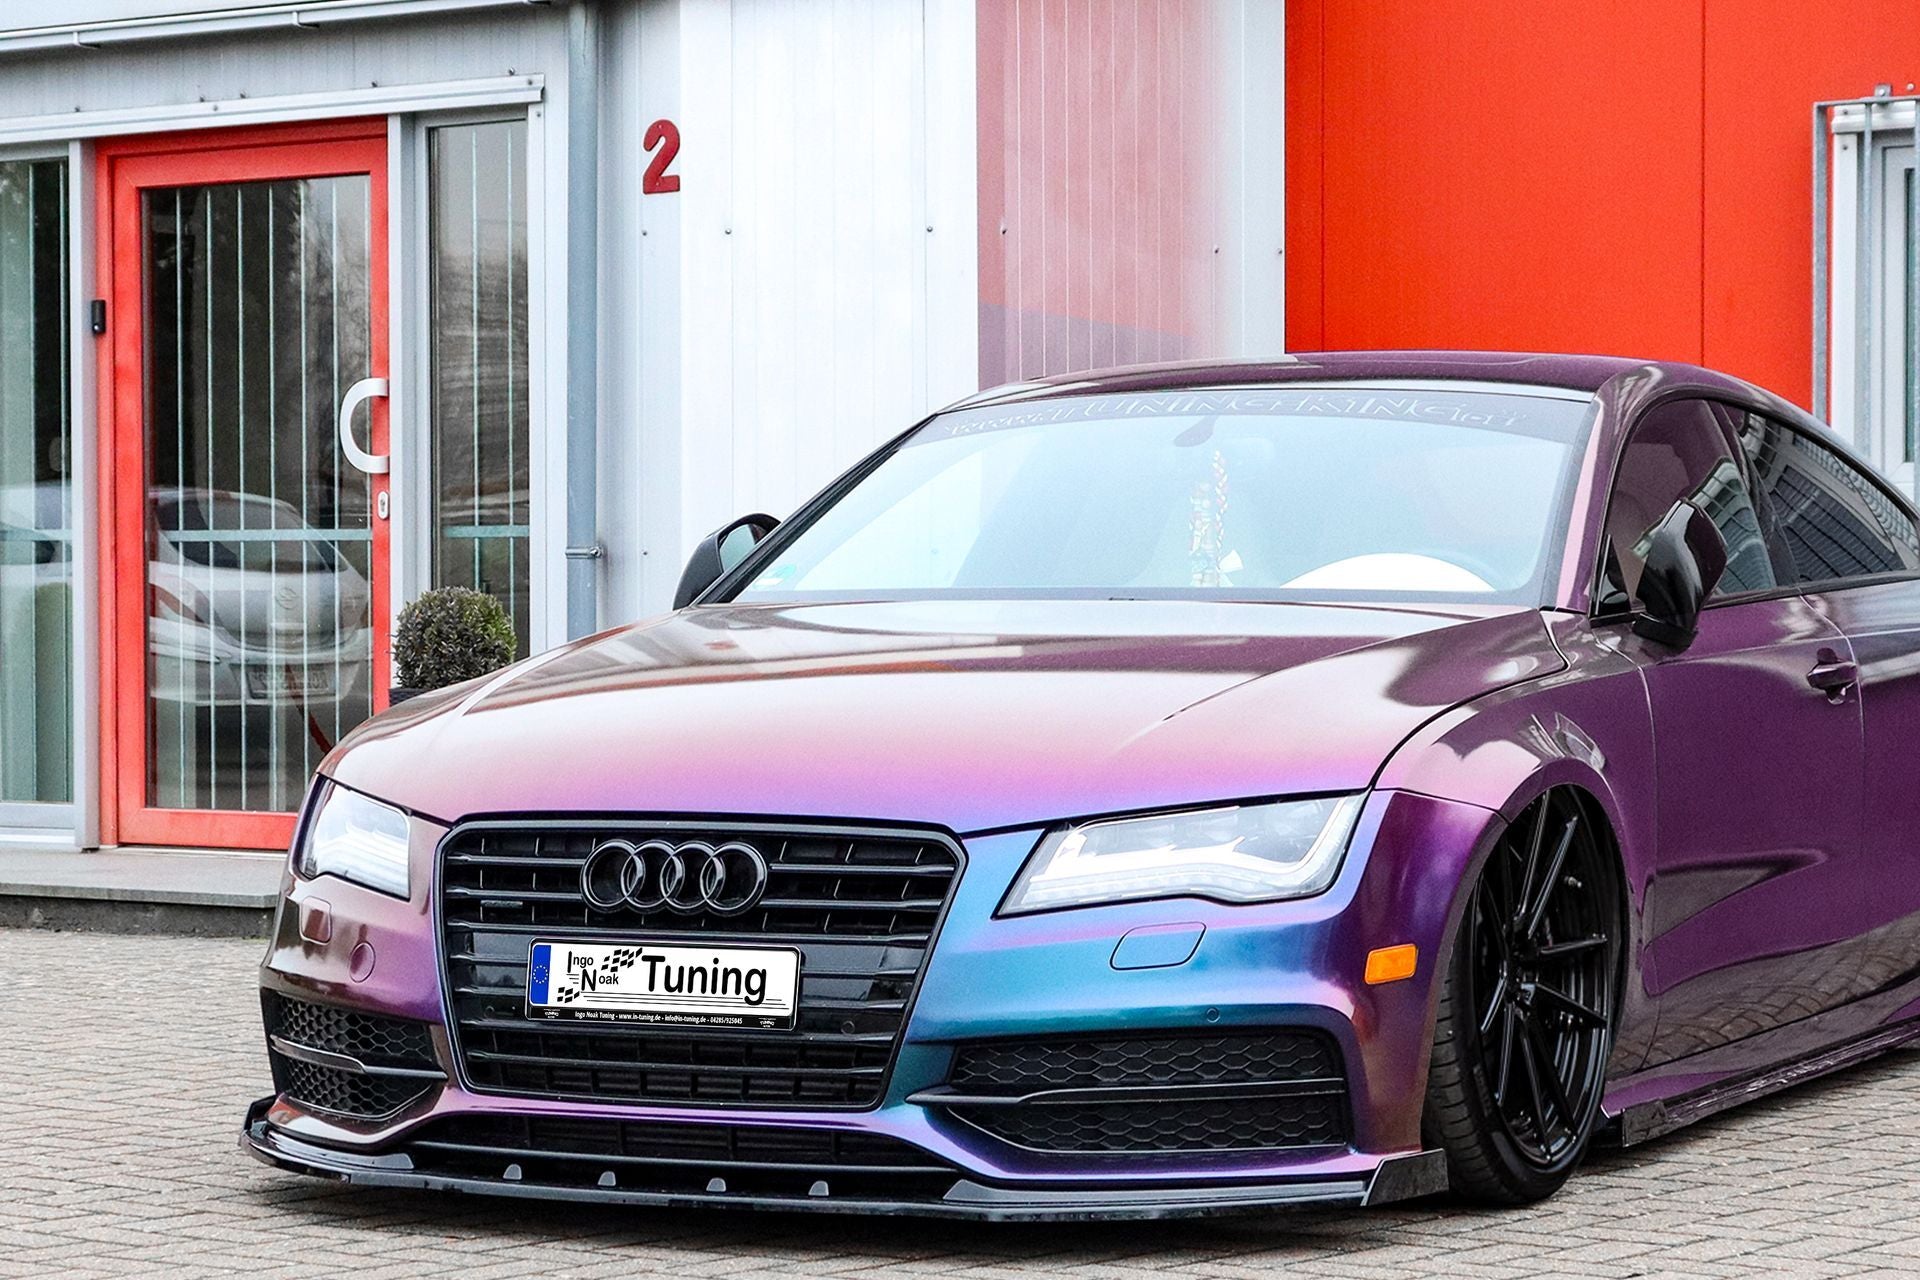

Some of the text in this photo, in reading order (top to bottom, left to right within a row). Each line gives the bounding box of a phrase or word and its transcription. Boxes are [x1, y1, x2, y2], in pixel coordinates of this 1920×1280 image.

[643, 119, 680, 194] 2
[567, 951, 594, 973] Ingo
[581, 969, 619, 992] Noak
[641, 954, 766, 1006] Tuning
[599, 1012, 615, 1020] Tuning
